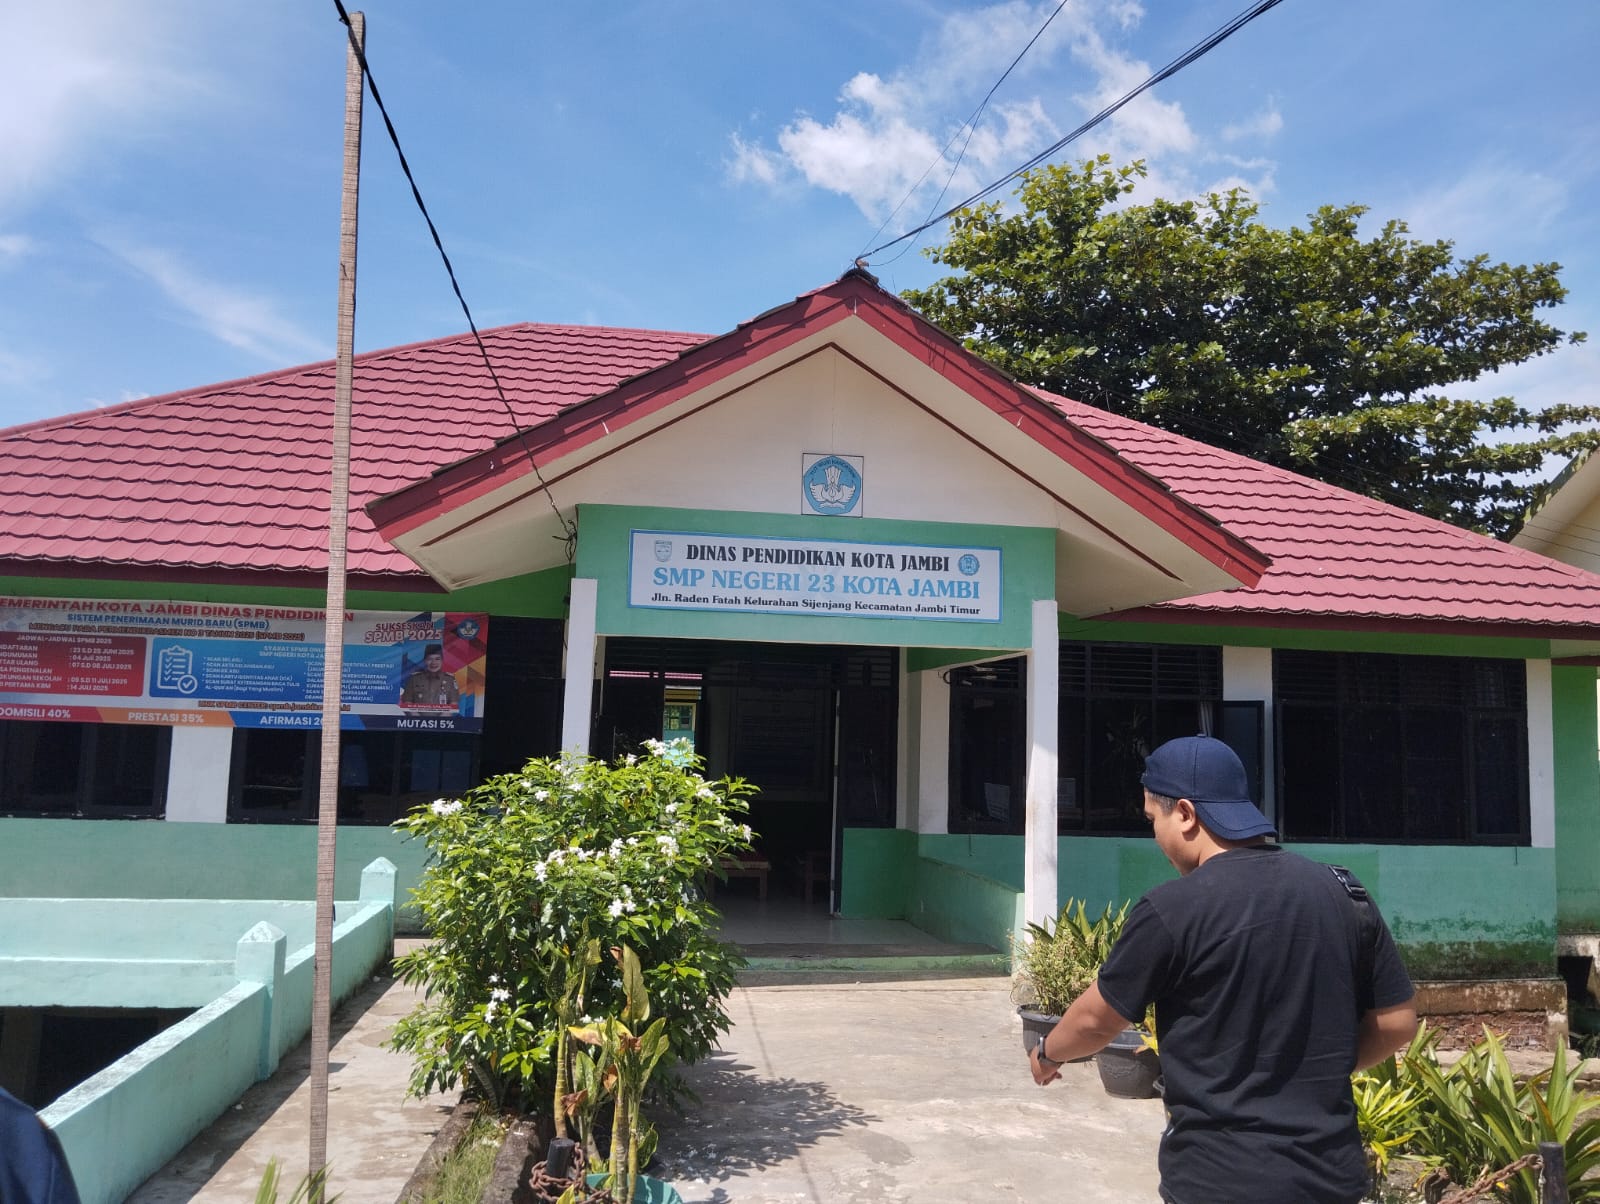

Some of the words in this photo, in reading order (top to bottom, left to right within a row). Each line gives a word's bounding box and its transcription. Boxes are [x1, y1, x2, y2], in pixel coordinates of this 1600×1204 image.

[686, 544, 736, 562] DINAS
[742, 547, 845, 567] PENDIDIKAN
[851, 552, 894, 569] KOTA
[901, 554, 949, 571] JAMBI
[653, 567, 705, 587] SMP
[711, 569, 801, 592] NEGERI
[807, 573, 835, 593] 23
[842, 575, 902, 597] KOTA
[907, 578, 979, 599] JAMBI
[0, 598, 93, 611] EMERINTAH
[97, 601, 141, 613] KOTA
[146, 603, 198, 616] JAMBI
[201, 605, 251, 618] DINAS
[255, 607, 354, 621] PENDIDIKN
[651, 593, 671, 603] Jln.
[674, 593, 709, 604] Raden
[712, 595, 740, 606] Fatah
[743, 596, 798, 607] Kelurahan
[801, 598, 851, 611] Sijenjang
[855, 601, 911, 613] Kecamatan
[914, 604, 946, 614] Jambi
[949, 605, 981, 616] Timur
[68, 613, 104, 623] SISTEM
[105, 615, 169, 625] PENERIMAAN
[172, 617, 203, 626] MURID
[206, 619, 232, 627] BARU
[234, 619, 269, 630] (SPMB)
[376, 621, 434, 631] SUKSESKAN
[366, 629, 405, 643] SPMB
[408, 629, 443, 642] 2025
[0, 651, 38, 659] NGUMUMAN
[48, 708, 71, 719] 40%
[128, 711, 180, 722] PRESTASI
[182, 714, 205, 724] 35%
[260, 715, 311, 726] AFIRMASI
[397, 719, 438, 729] MUTASI
[440, 720, 455, 729] 5%
